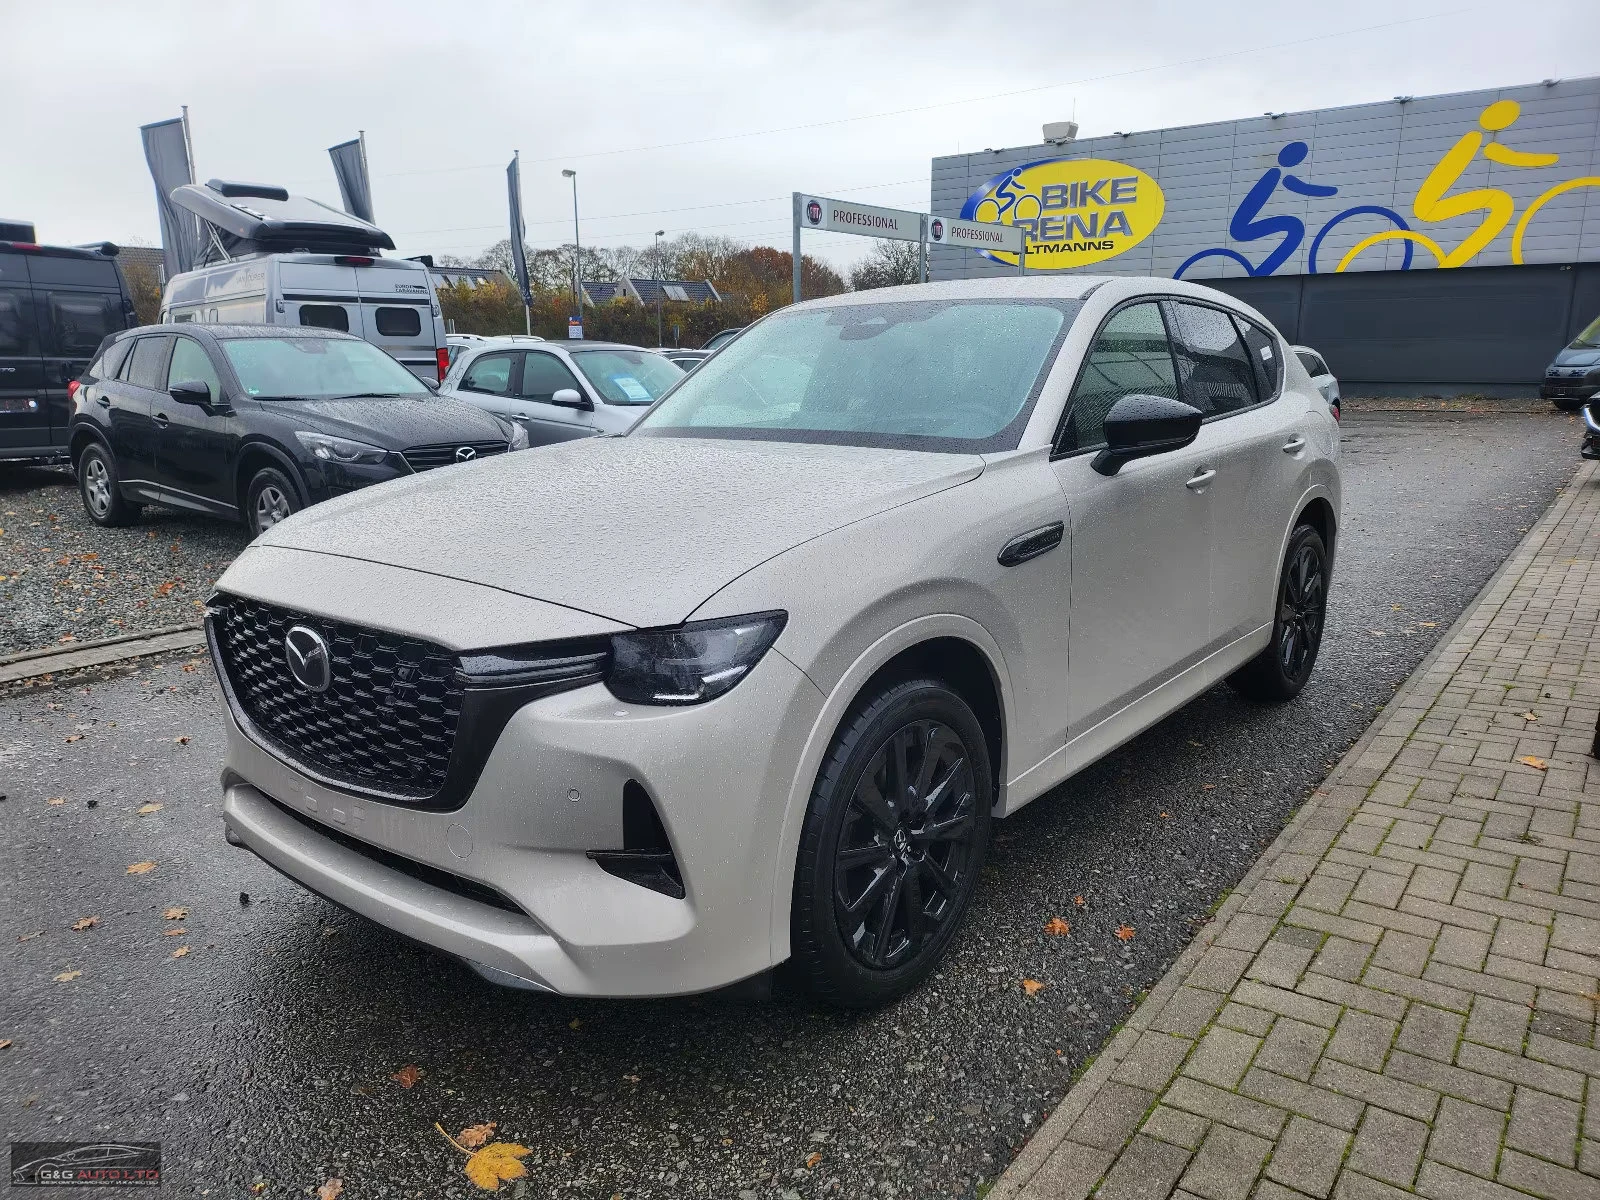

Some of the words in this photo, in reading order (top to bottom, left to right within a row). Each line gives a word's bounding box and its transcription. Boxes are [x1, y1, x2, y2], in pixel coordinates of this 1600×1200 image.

[1041, 176, 1138, 210] BIKE
[833, 209, 899, 230] PROFESSIONAL
[1011, 210, 1134, 242] RENA
[951, 226, 1004, 243] PROFESSIONAL
[1013, 240, 1115, 255] LTMANNS
